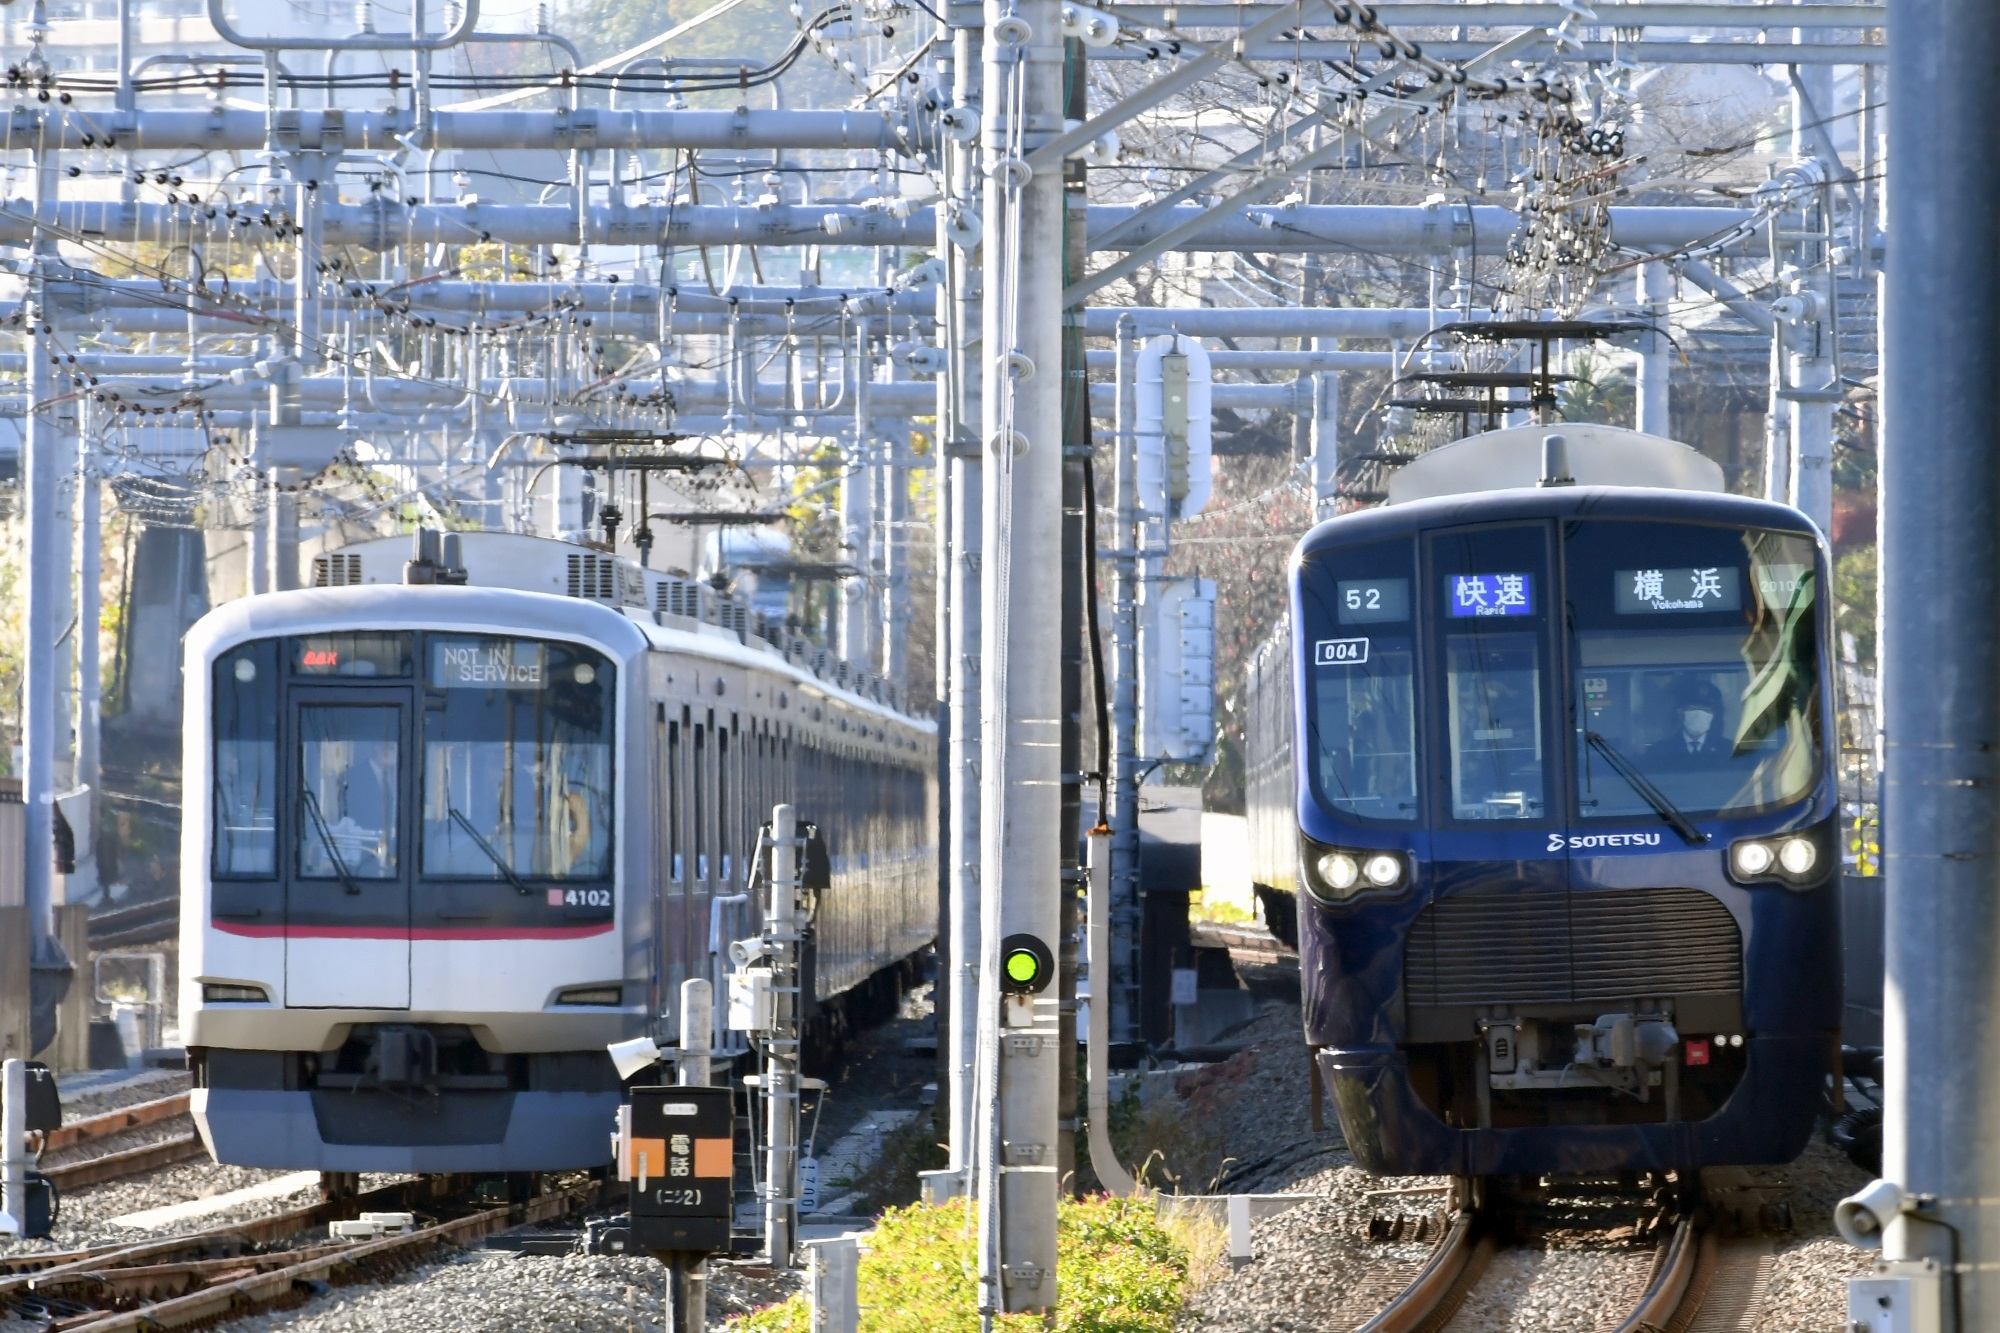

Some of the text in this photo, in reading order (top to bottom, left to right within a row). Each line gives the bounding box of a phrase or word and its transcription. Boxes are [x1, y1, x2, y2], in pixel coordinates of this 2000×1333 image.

[1456, 574, 1526, 607] 快速
[1633, 567, 1722, 601] 横浜
[1346, 588, 1381, 610] 52
[1651, 599, 1704, 610] Yokohama
[444, 647, 507, 666] NOT IN
[1325, 643, 1357, 660] 004
[460, 664, 541, 682] SERVICE
[1568, 833, 1661, 849] SOTETSU
[565, 889, 611, 907] 4102
[670, 1134, 691, 1177] 電話
